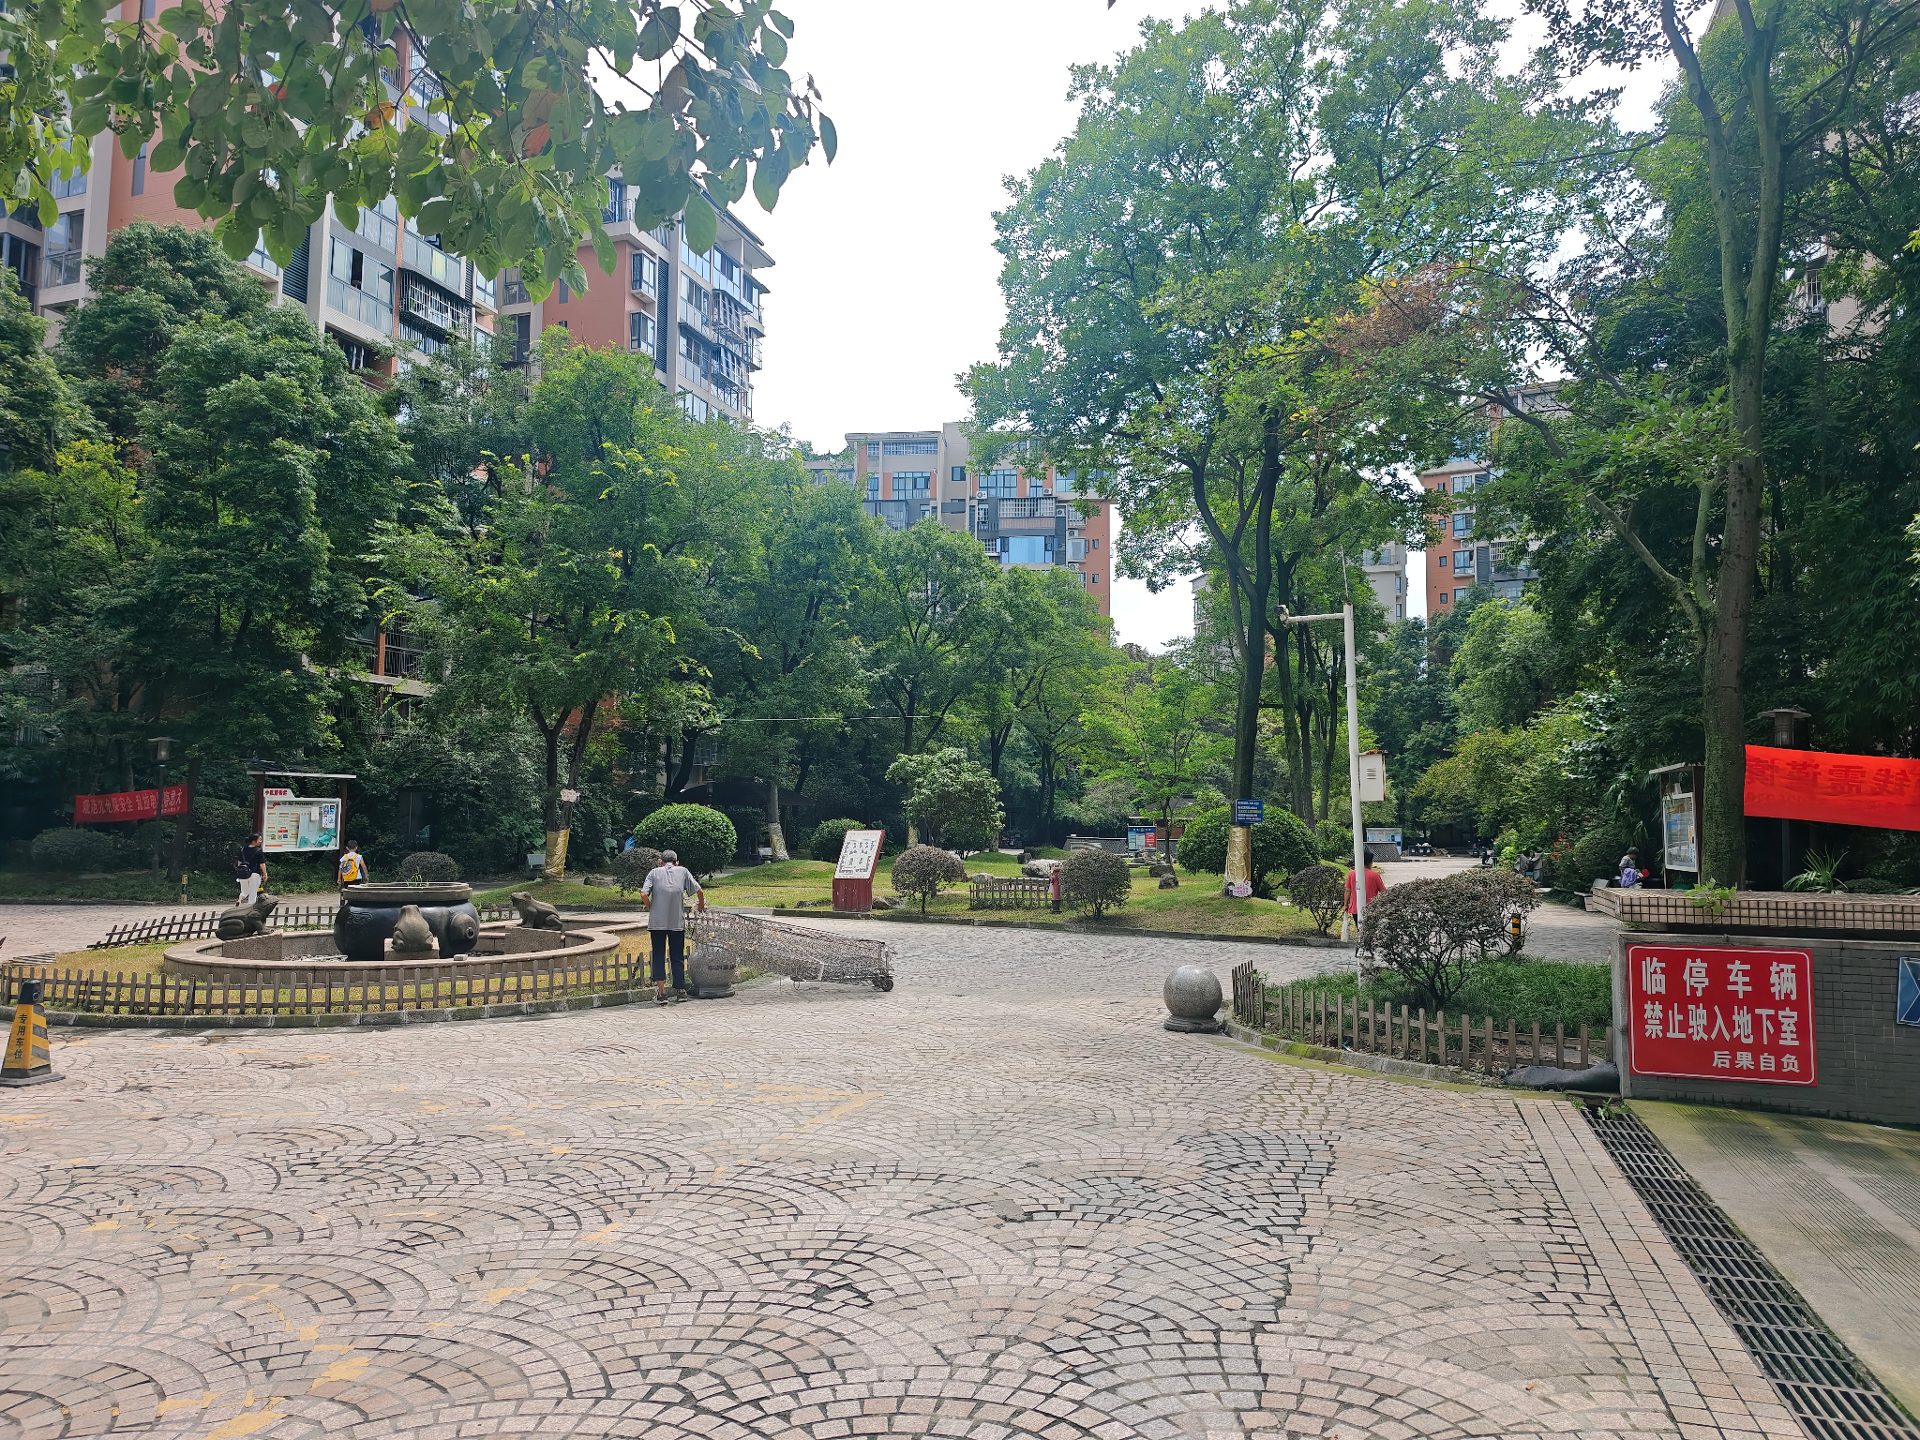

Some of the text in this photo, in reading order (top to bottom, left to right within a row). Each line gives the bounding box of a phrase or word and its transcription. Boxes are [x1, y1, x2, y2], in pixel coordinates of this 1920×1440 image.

[1641, 957, 1797, 1000] 临停车辆
[14, 1013, 28, 1060] 专用车位
[1644, 1001, 1800, 1046] 禁止驶入地下室
[1712, 1050, 1800, 1073] 后果自负
